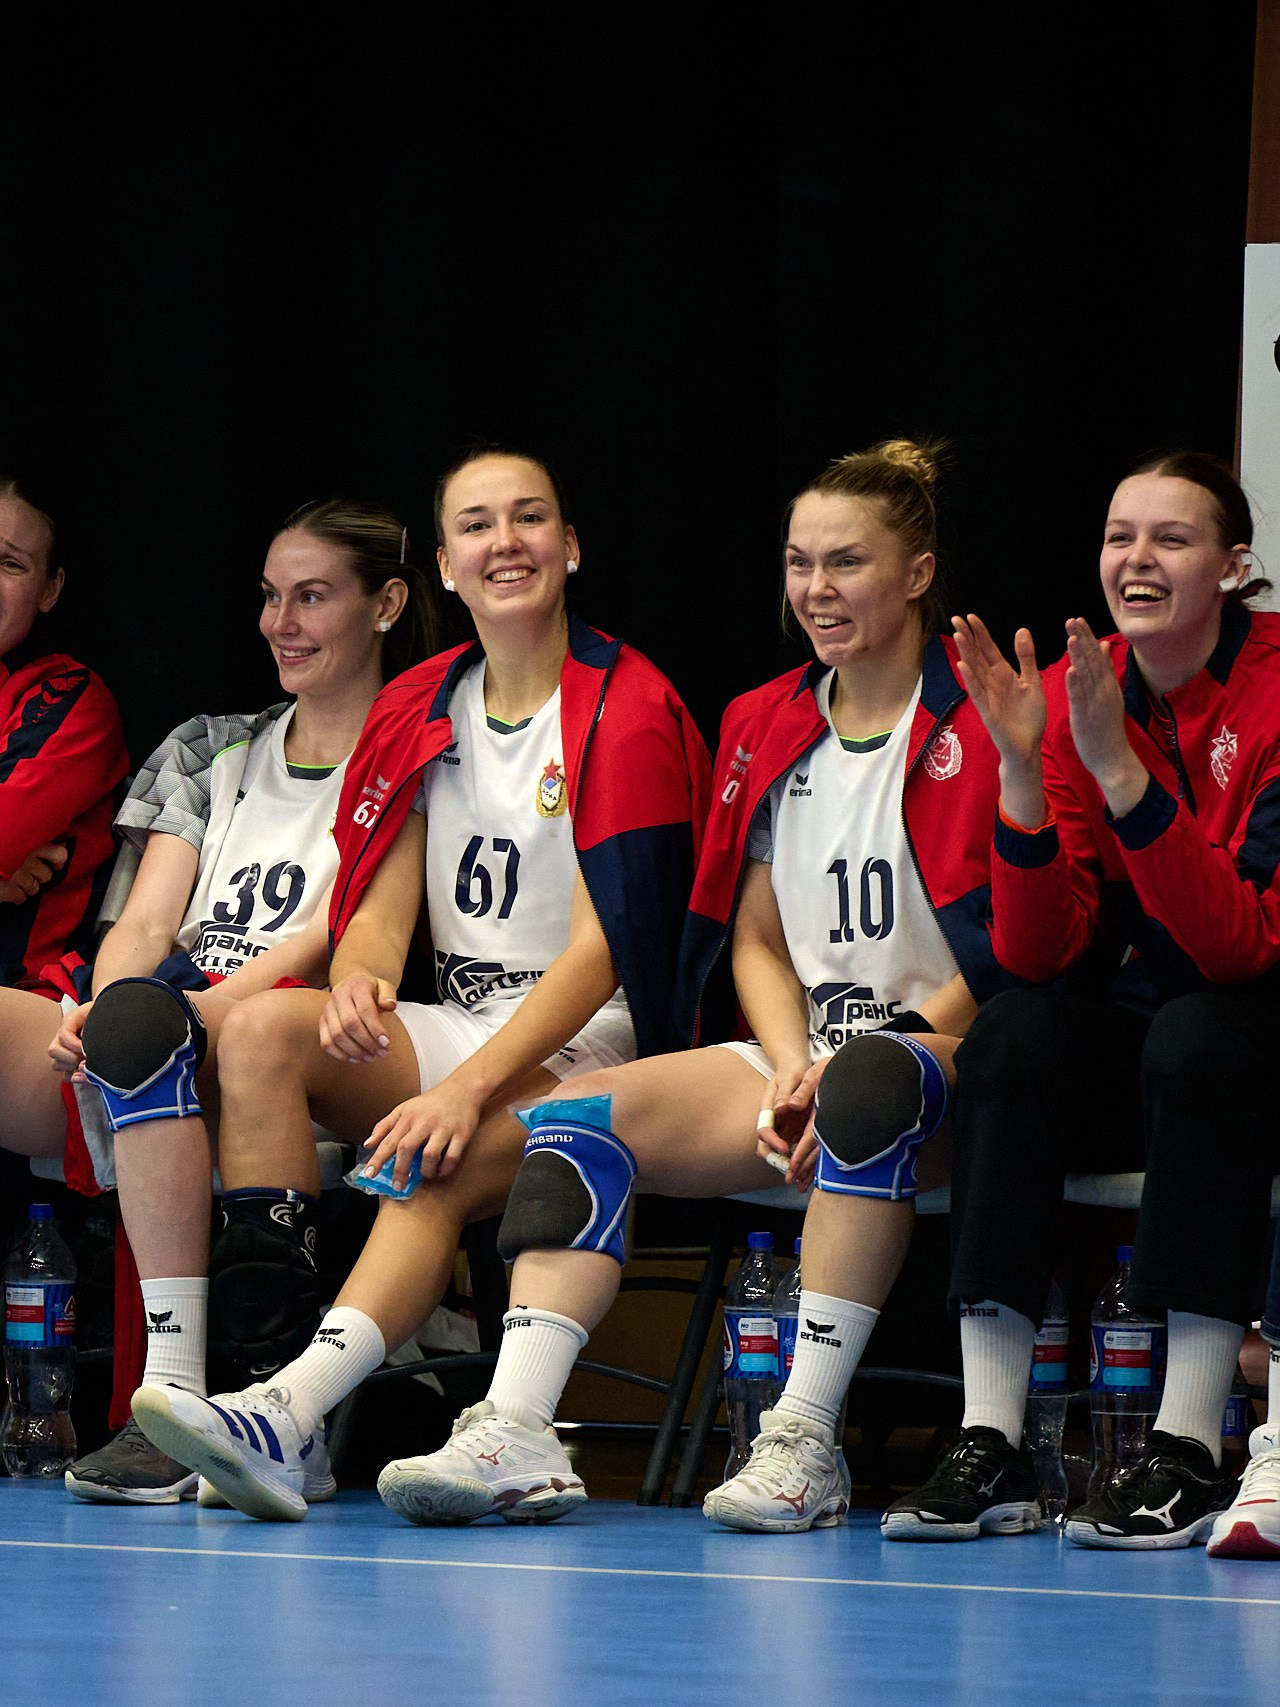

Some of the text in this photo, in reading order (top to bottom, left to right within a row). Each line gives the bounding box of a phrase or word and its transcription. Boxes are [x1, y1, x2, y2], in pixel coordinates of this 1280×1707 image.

[213, 860, 306, 932] 39
[455, 834, 521, 920] 67
[826, 856, 895, 944] 10
[800, 1331, 842, 1348] erima
